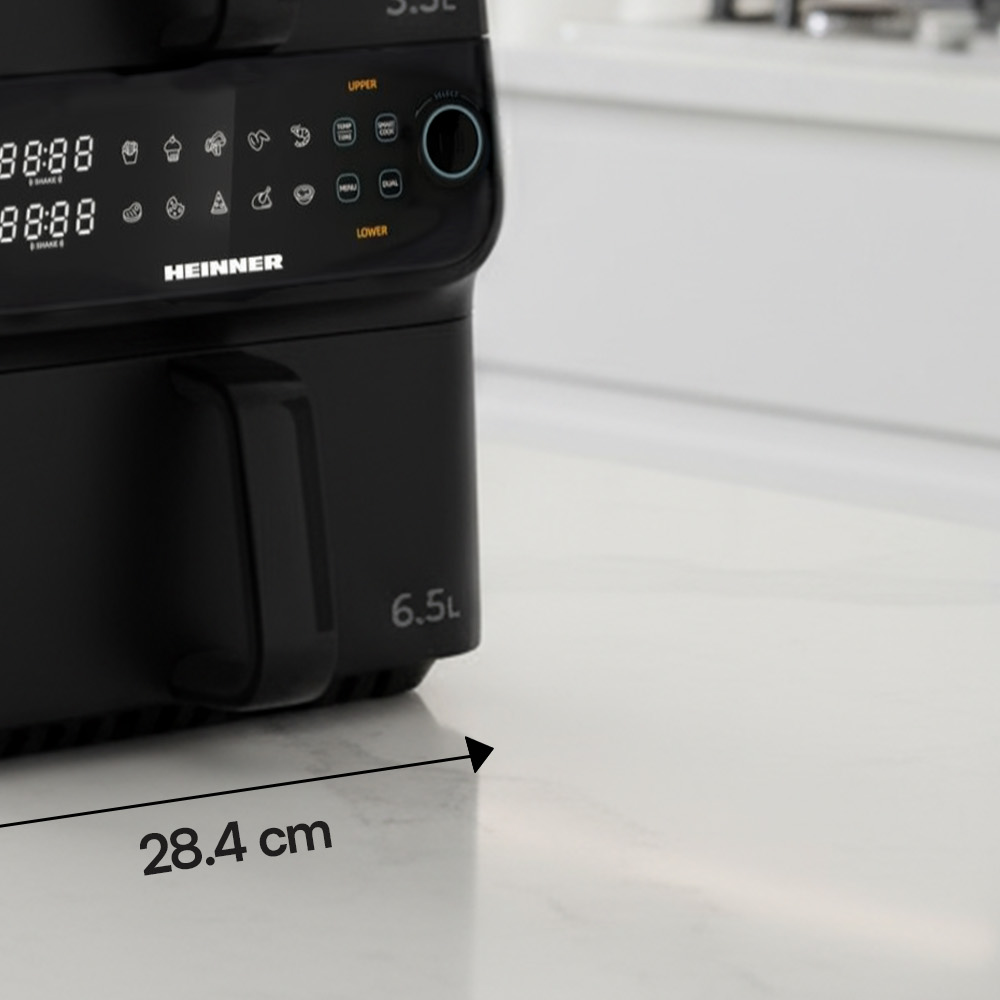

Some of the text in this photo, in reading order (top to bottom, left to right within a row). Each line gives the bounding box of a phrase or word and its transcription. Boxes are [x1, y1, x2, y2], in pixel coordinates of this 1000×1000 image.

[348, 79, 377, 91] UPPER
[356, 225, 388, 239] LOWER
[165, 254, 282, 281] HEINNER
[392, 588, 461, 627] 6.5L
